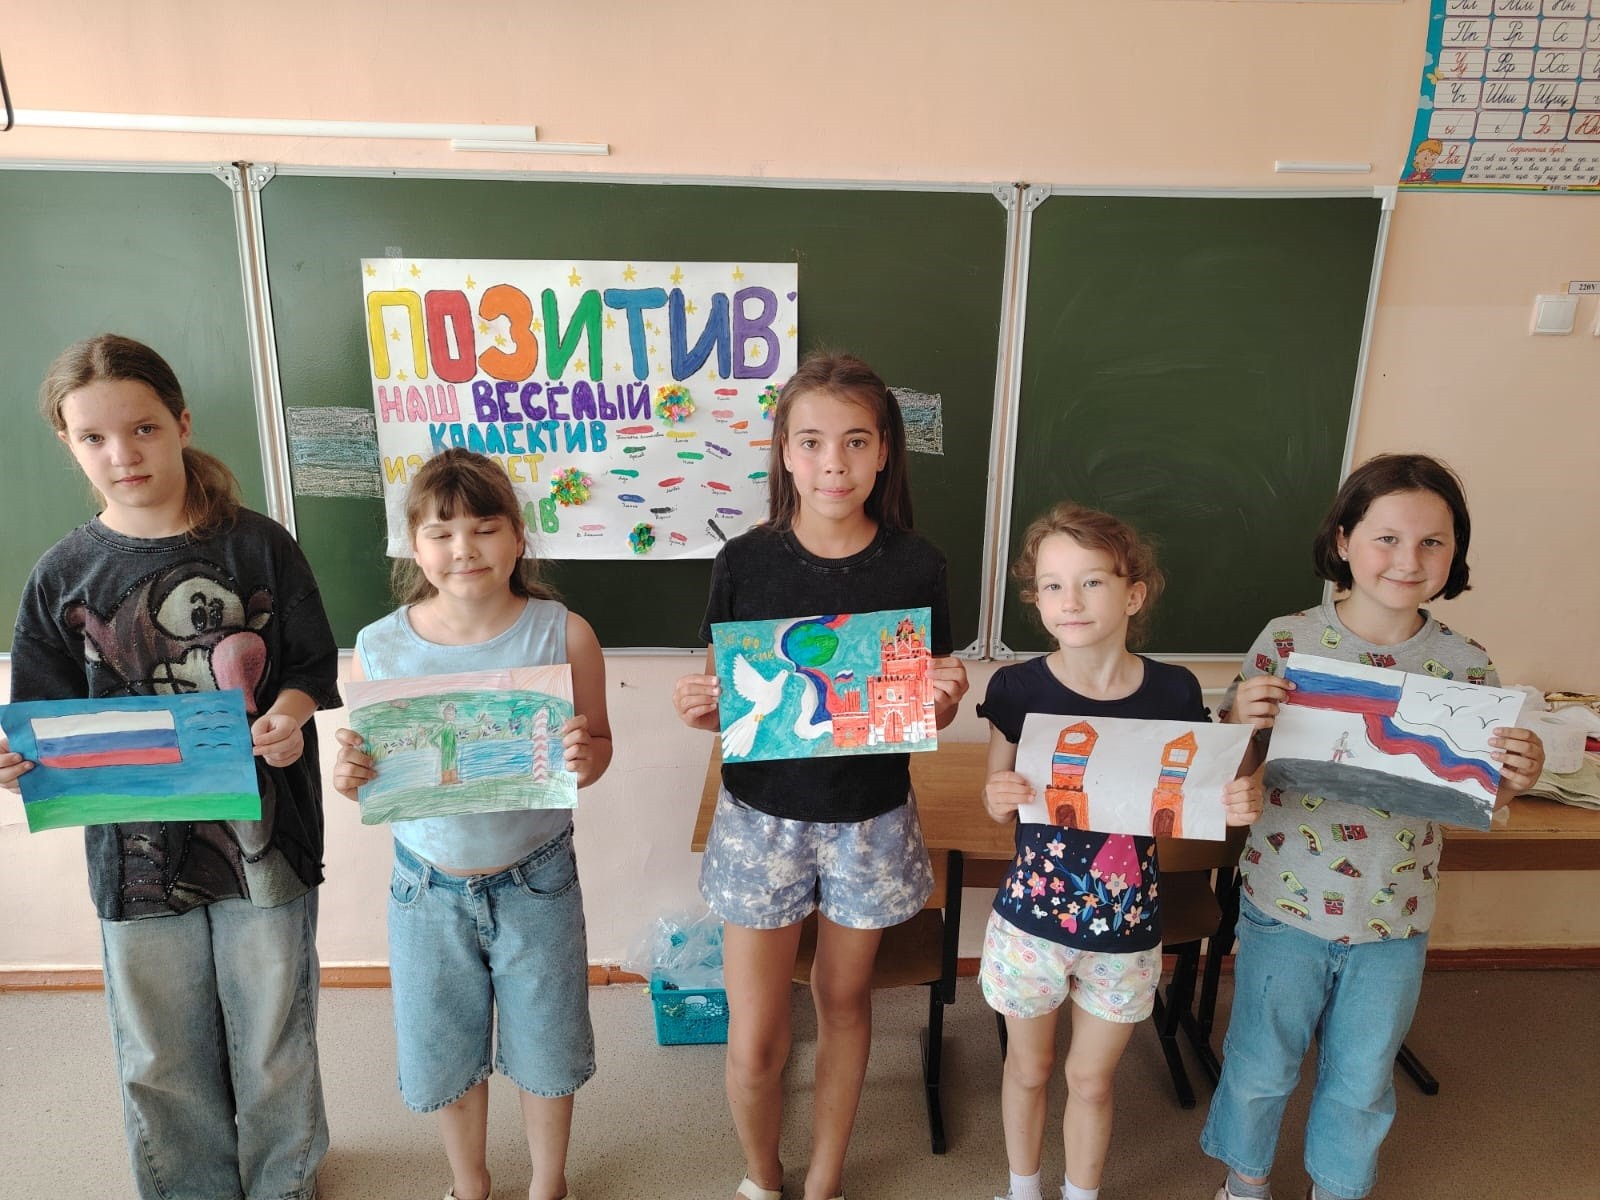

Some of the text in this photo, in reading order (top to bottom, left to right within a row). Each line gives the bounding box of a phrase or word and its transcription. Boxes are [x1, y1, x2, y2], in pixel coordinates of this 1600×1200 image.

[1451, 21, 1480, 41] Пп
[1503, 21, 1524, 47] Рр
[1553, 22, 1569, 42] Сс
[1492, 52, 1516, 78] Фф
[1540, 53, 1569, 73] Хх
[1450, 83, 1467, 103] Чч
[1485, 83, 1517, 104] Шш
[1534, 83, 1569, 109] Щщ
[1533, 114, 1551, 134] Ээ
[1438, 145, 1461, 164] Яя
[367, 284, 780, 382] ПОЗИТИВ
[378, 380, 651, 423] НАШ ВЕСЁЛЫЙ
[429, 420, 607, 454] КОЛЛЕКТИВ
